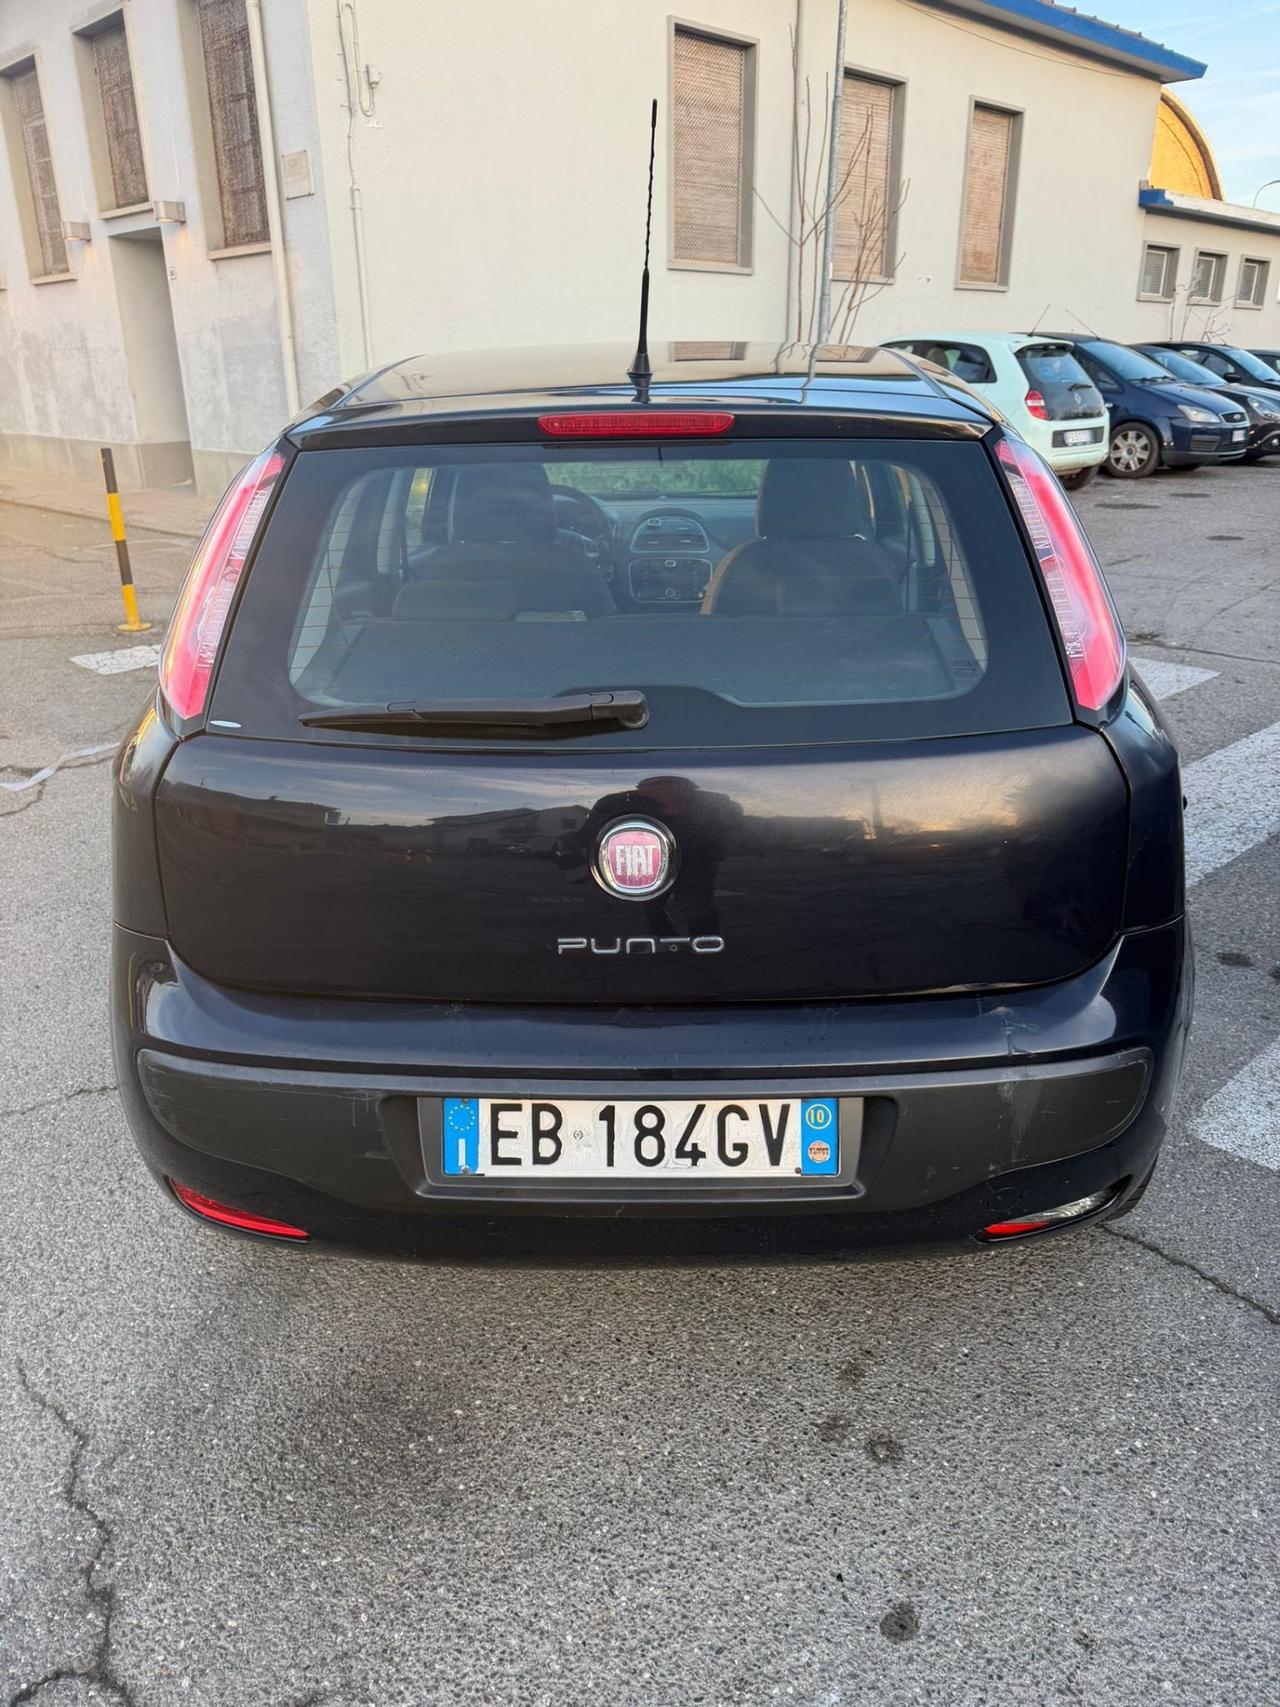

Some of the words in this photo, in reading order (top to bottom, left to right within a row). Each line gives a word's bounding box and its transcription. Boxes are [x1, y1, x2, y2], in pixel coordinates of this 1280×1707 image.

[615, 845, 657, 877] FIAT
[557, 936, 725, 955] PUNTO
[810, 1109, 824, 1124] 10
[490, 1103, 563, 1167] EB
[598, 1103, 791, 1168] 184GV
[458, 1138, 466, 1166] I
